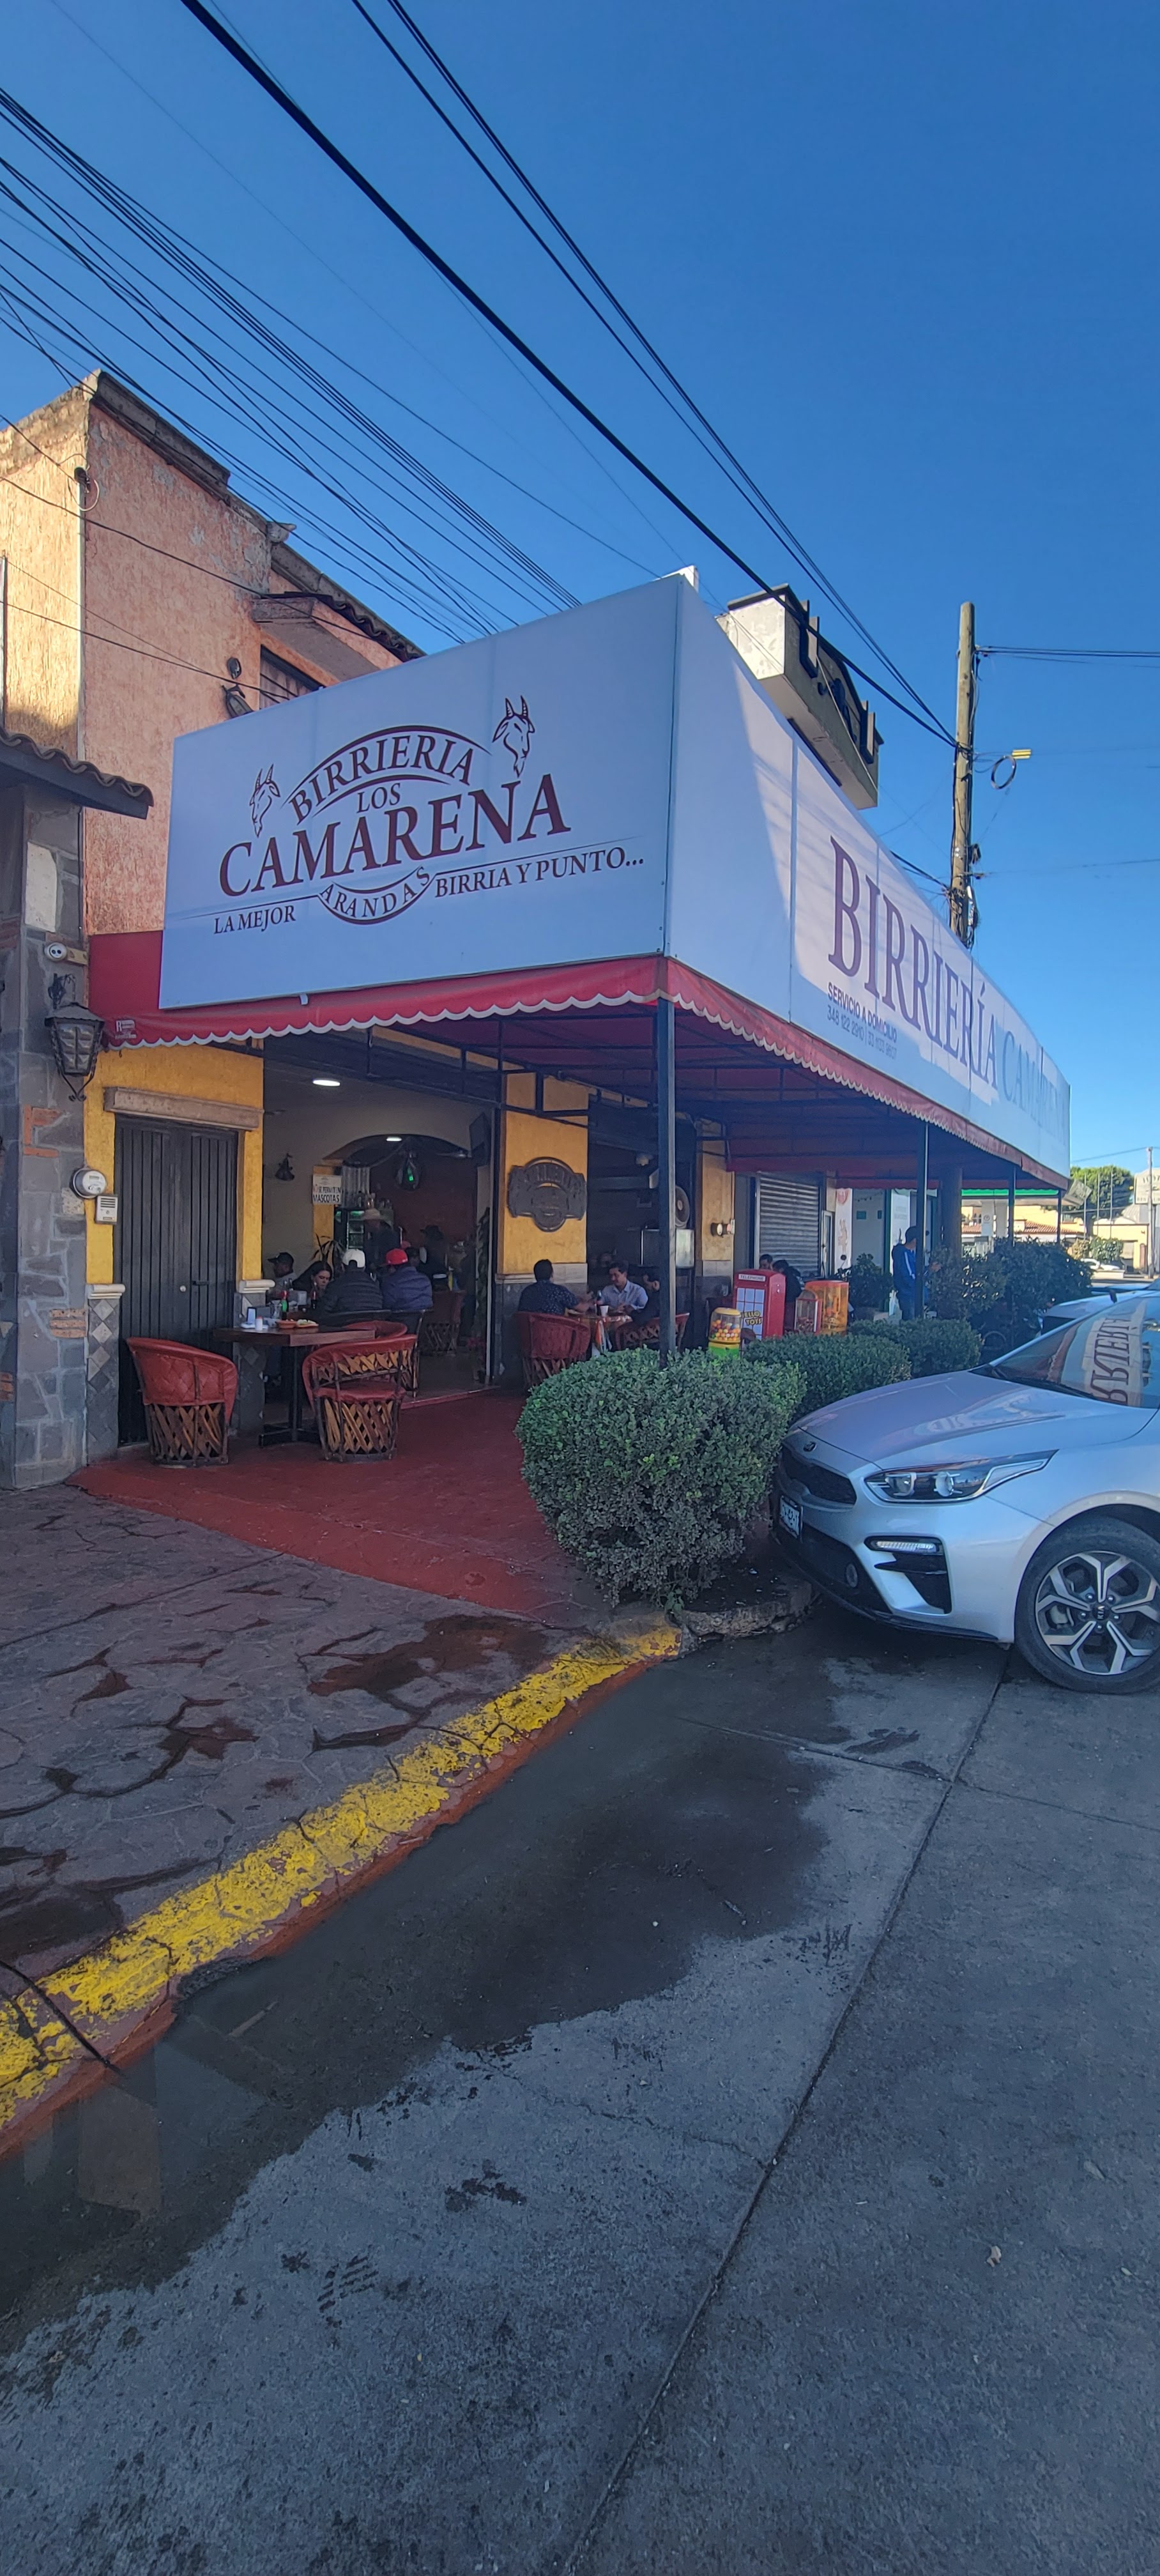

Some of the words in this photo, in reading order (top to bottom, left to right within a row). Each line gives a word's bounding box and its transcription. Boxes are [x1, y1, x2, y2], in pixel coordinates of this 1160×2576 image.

[287, 735, 474, 825] BIRRIERIA
[356, 783, 401, 813] LOS
[219, 774, 572, 897] CAMARENA
[214, 916, 235, 934] LA
[237, 905, 296, 931] MEJOR
[435, 867, 512, 898] BIRRIA
[515, 862, 532, 884] Y
[535, 847, 644, 881] PUNTO...
[319, 866, 430, 918] ARANDAS
[828, 836, 998, 1091] BIRRIERÍA
[827, 981, 860, 1019] SERVICIO
[862, 1006, 867, 1024] A
[867, 1009, 897, 1043] DOMICILIO
[827, 1004, 840, 1026] 348
[841, 1013, 850, 1032] 122
[312, 1194, 340, 1203] MASCOTAS
